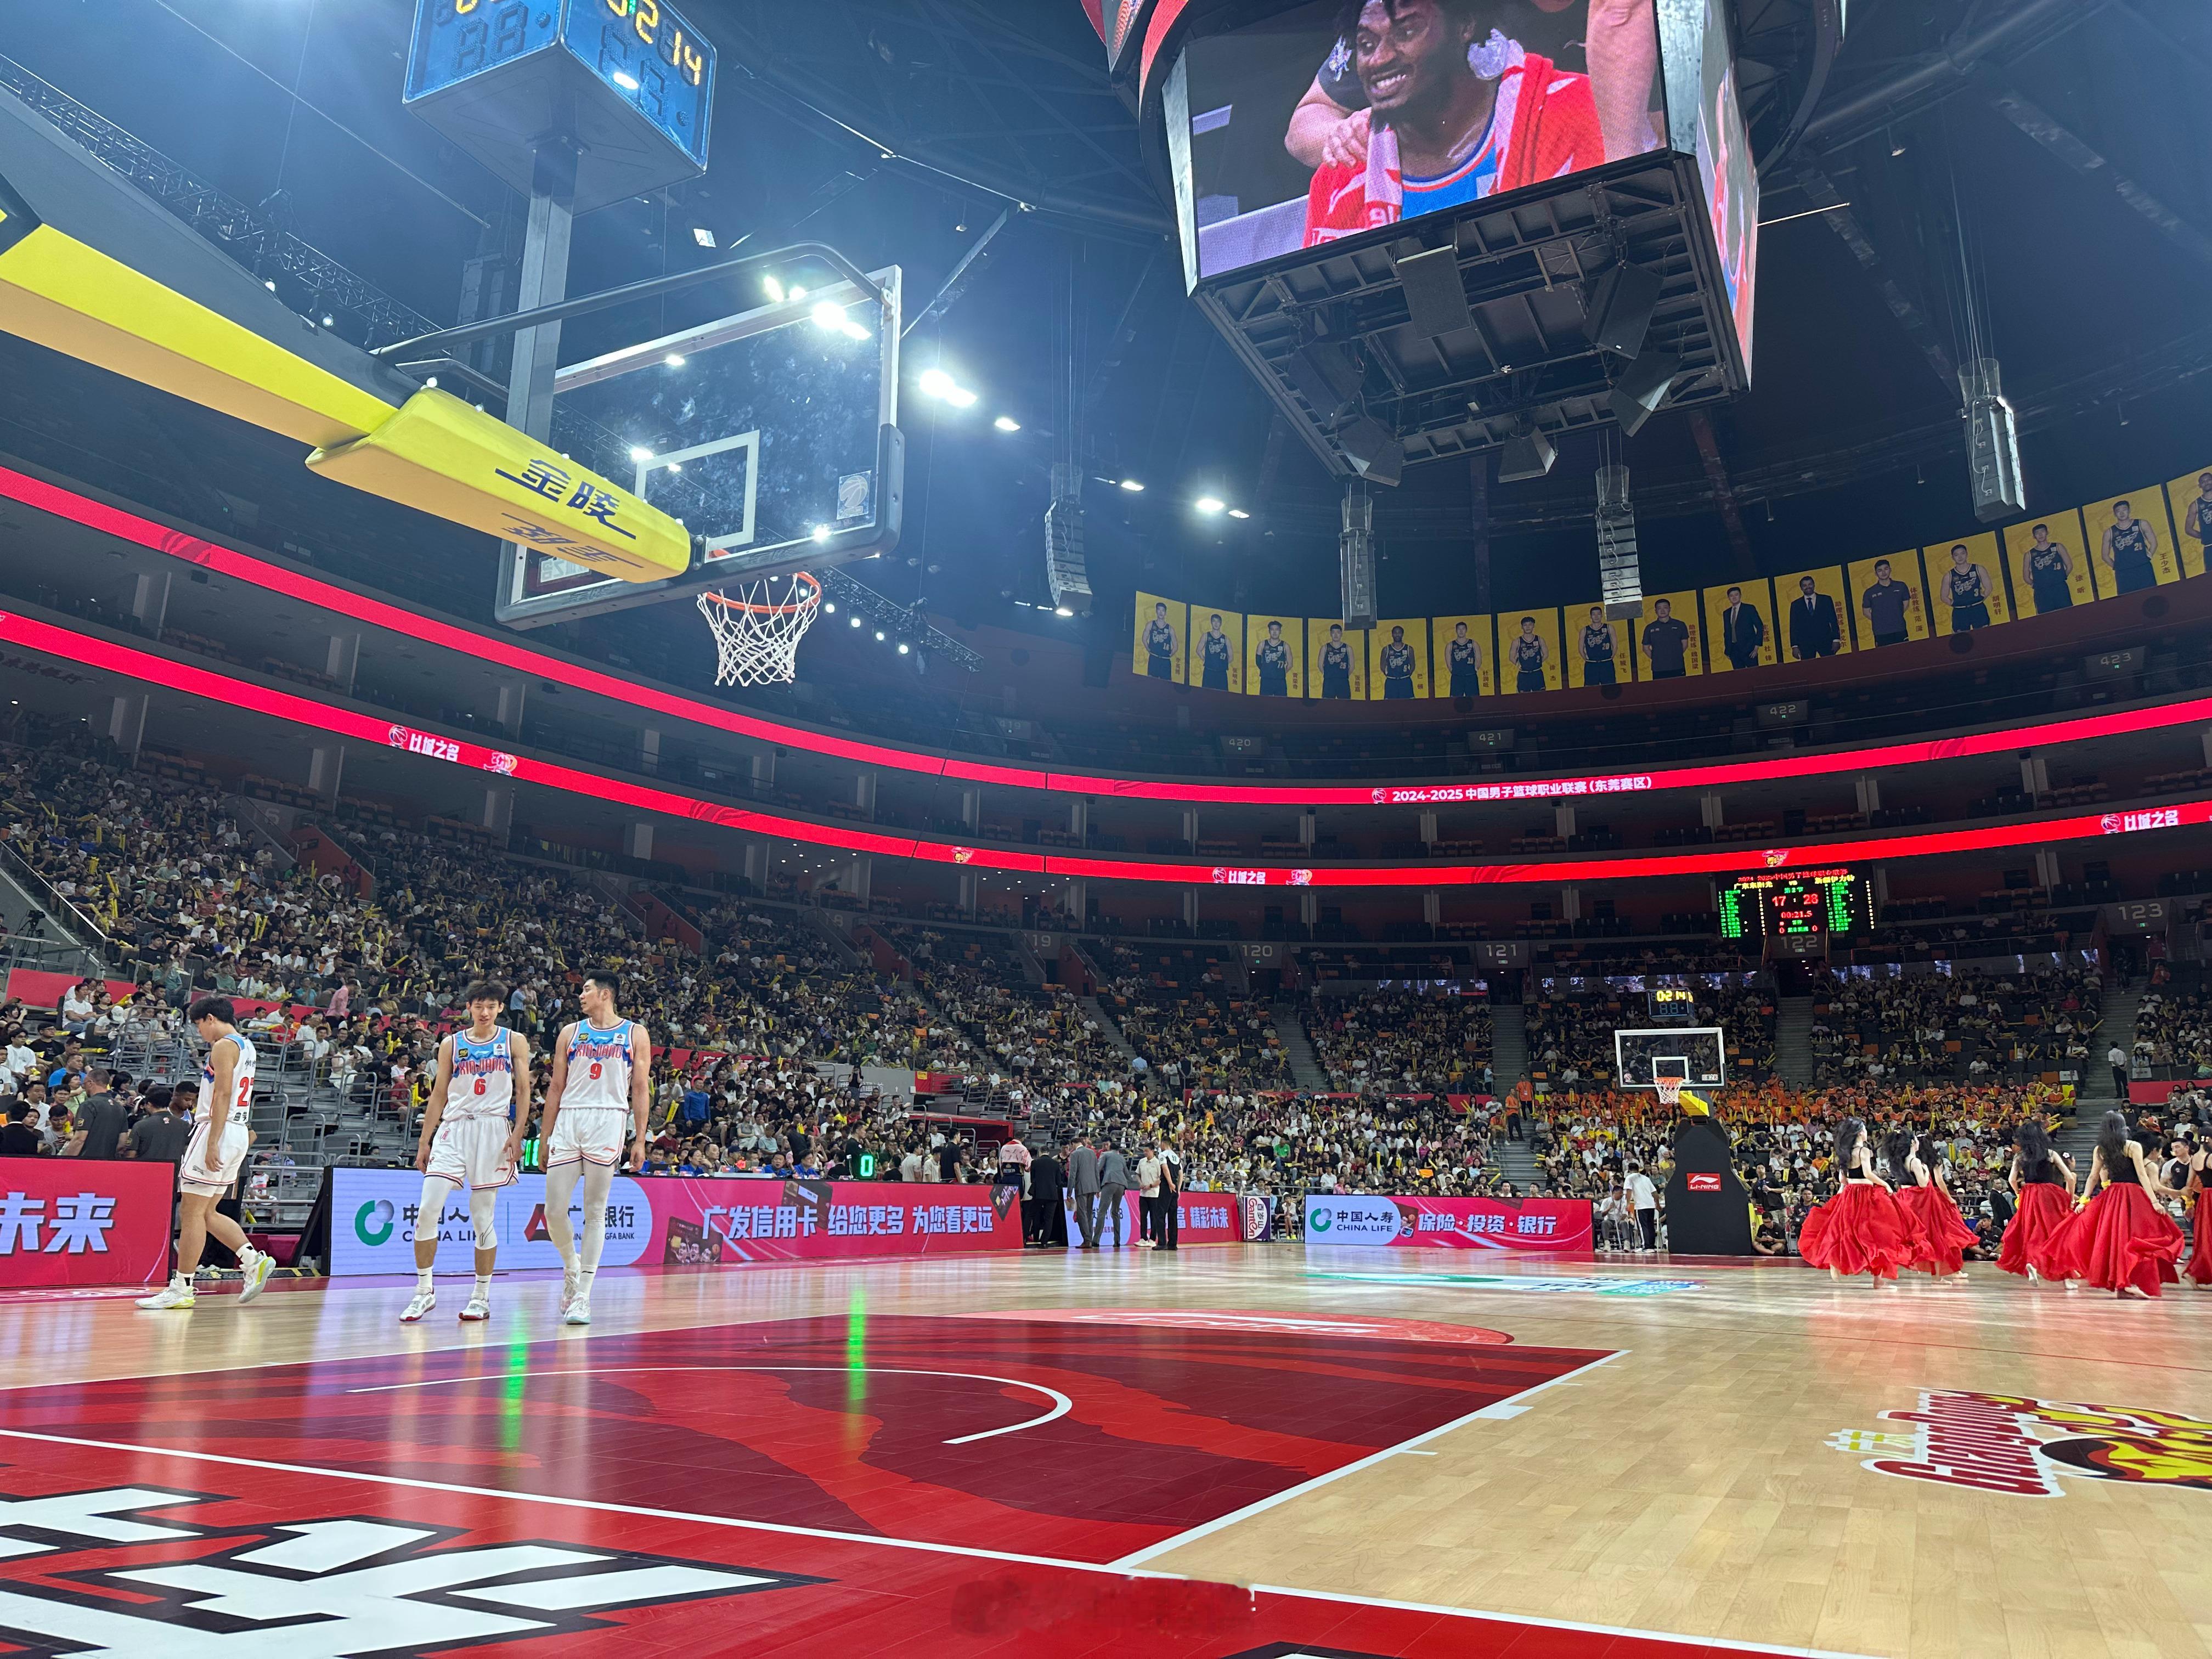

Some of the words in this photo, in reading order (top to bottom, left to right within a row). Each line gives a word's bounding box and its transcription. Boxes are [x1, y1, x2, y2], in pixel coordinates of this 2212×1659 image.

[495, 458, 636, 540] 金陵
[2159, 552, 2171, 574] 王少杰
[1992, 595, 2002, 616] 胡明轩
[2100, 652, 2132, 666] 423
[1770, 704, 1797, 716] 422
[1229, 738, 1251, 747] 420
[1479, 732, 1502, 742] 421
[1392, 789, 1464, 802] 2024-2025
[1771, 895, 1787, 907] 17
[1802, 893, 1819, 905] 28
[1781, 910, 1813, 919] 00:21.5
[2118, 904, 2163, 921] 123
[1486, 944, 1517, 957] 121
[1780, 935, 1819, 950] 122
[1242, 944, 1273, 958] 120
[575, 1043, 623, 1059] XINJIANG
[458, 1057, 506, 1075] XINJIANG
[589, 1063, 602, 1080] 9
[474, 1079, 486, 1096] 6
[860, 1154, 874, 1178] 0
[0, 1191, 116, 1255] 未来
[567, 1205, 634, 1228] 广银行
[702, 1205, 818, 1240] 广发信用卡
[828, 1204, 904, 1235] 给您更多
[913, 1205, 994, 1233] 为您看更远
[1189, 1206, 1229, 1229] 精彩未来
[1336, 1210, 1394, 1223] 中国人寿
[1336, 1224, 1368, 1232] CHINA
[1371, 1224, 1393, 1232] LIFE
